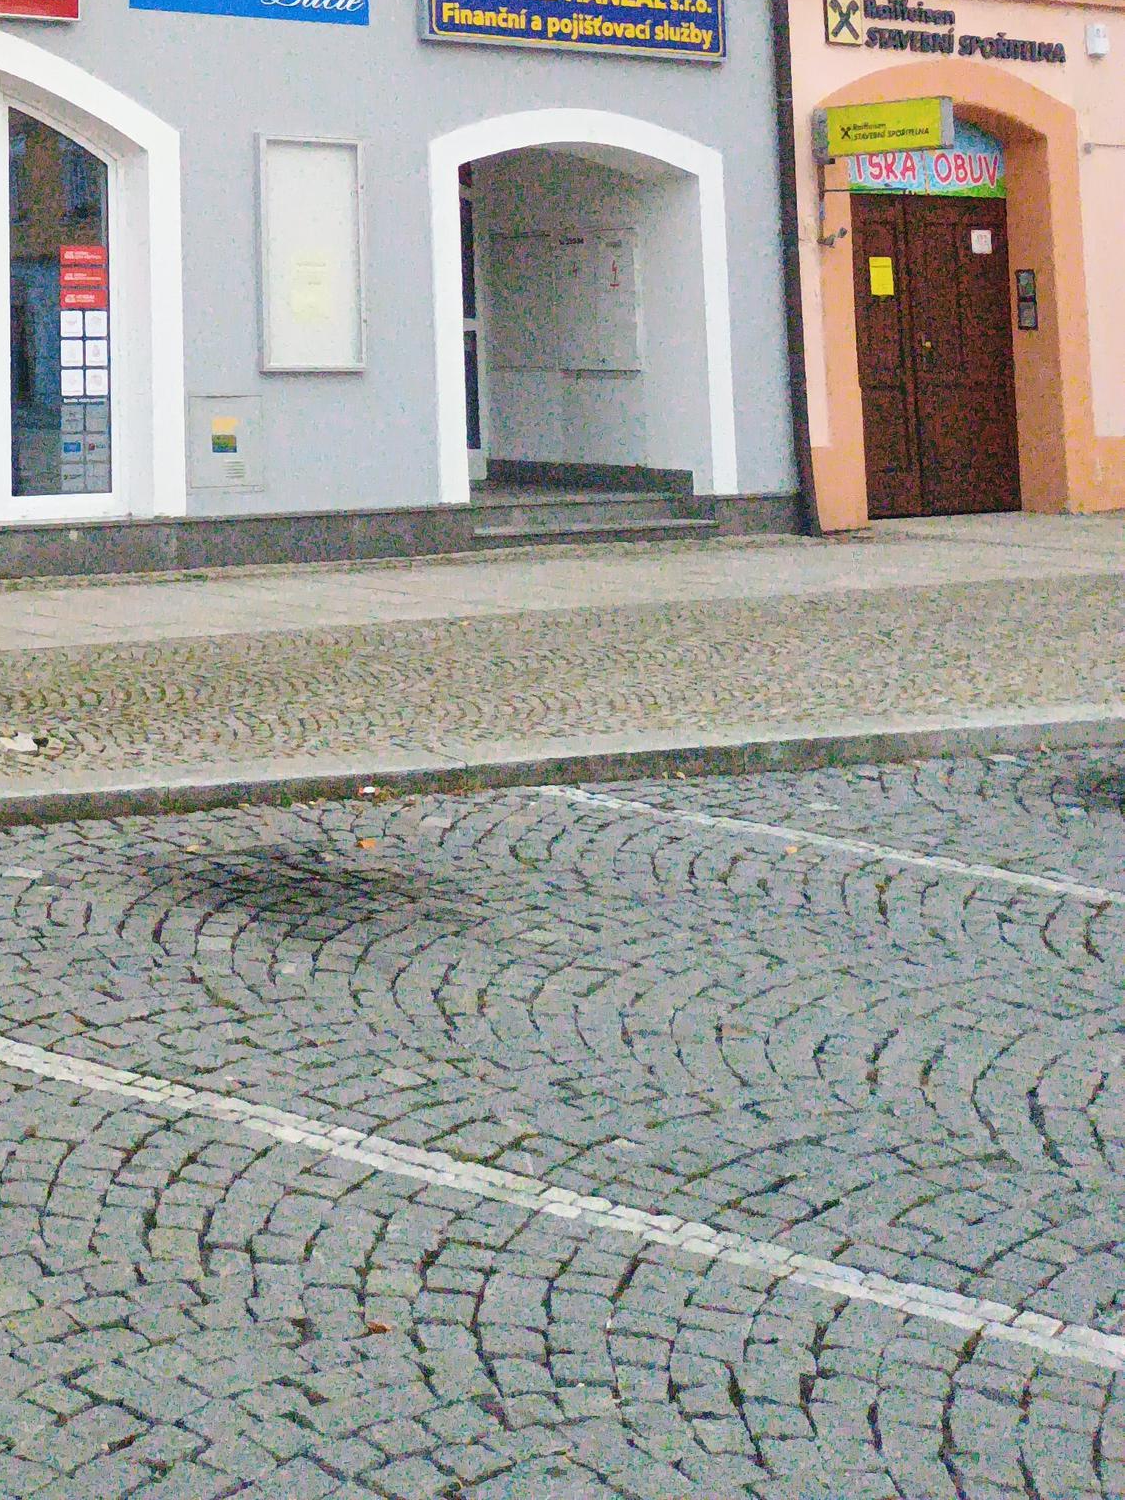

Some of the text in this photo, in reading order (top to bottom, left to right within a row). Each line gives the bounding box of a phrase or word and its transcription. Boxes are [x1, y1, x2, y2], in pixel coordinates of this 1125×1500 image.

[441, 2, 714, 50] Finanční a pojišťovací služby
[864, 26, 1067, 63] STAVEBNÍ SPOŘITELNA
[934, 153, 998, 188] OBUV
